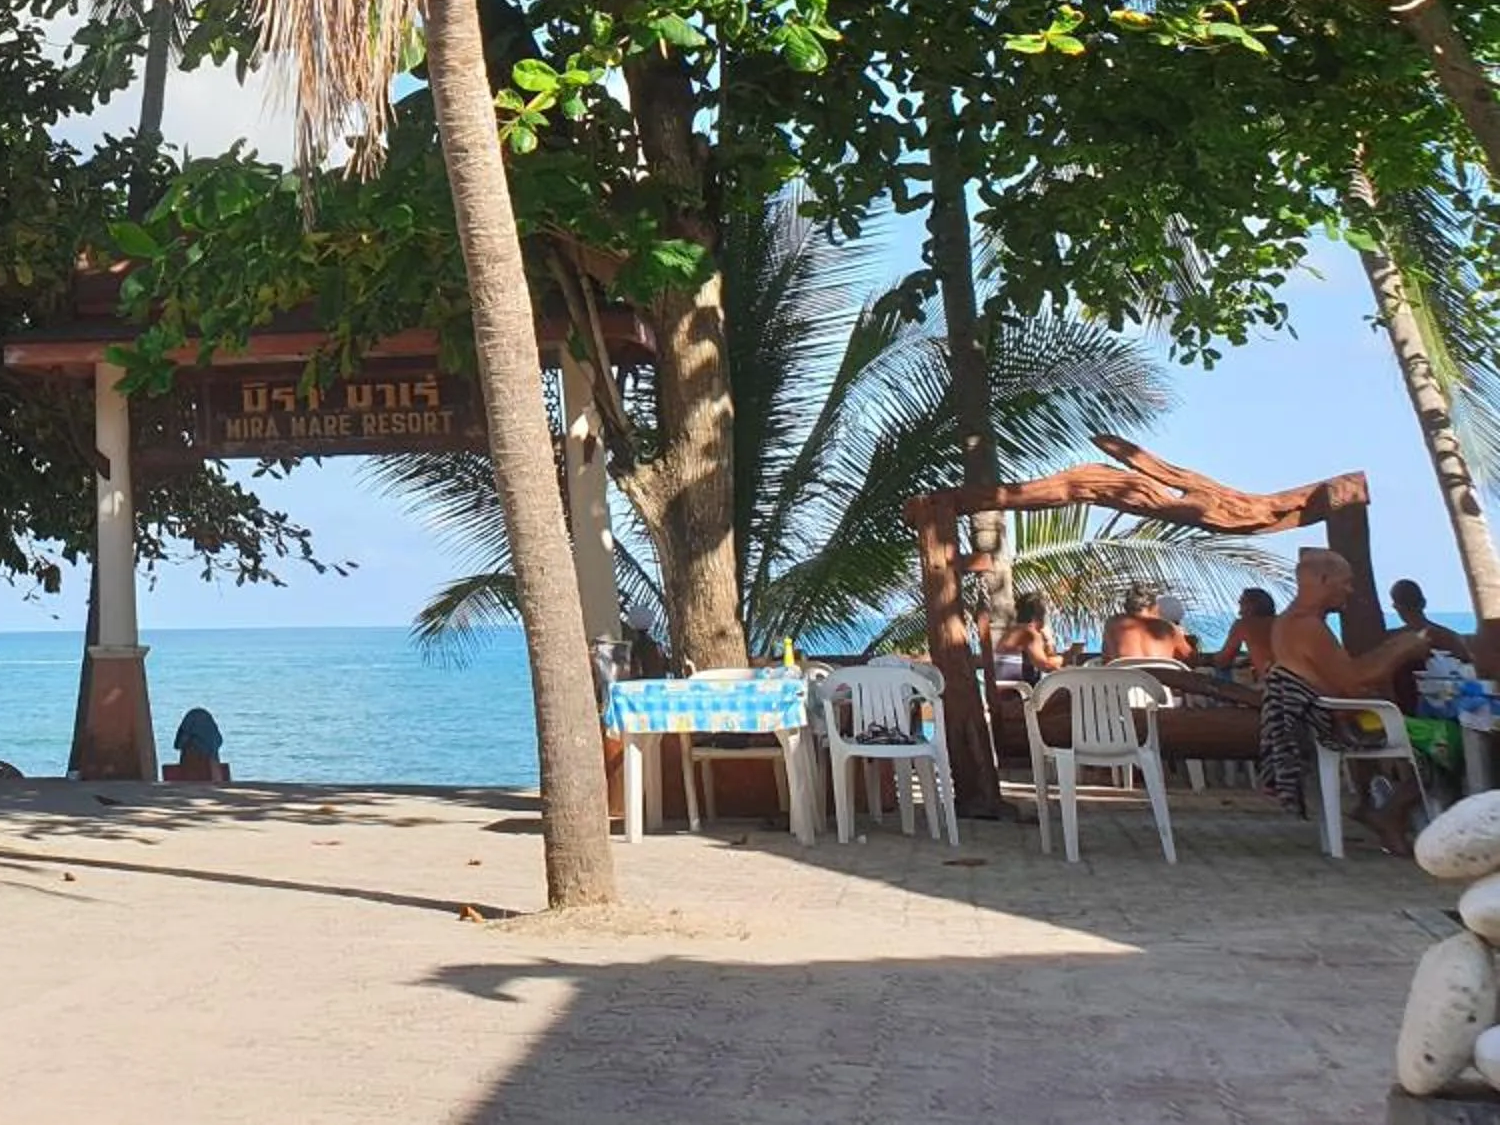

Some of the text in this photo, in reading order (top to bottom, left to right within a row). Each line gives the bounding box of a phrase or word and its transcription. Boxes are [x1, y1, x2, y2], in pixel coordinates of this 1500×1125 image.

[226, 410, 454, 439] MIRA MARE RESORT
